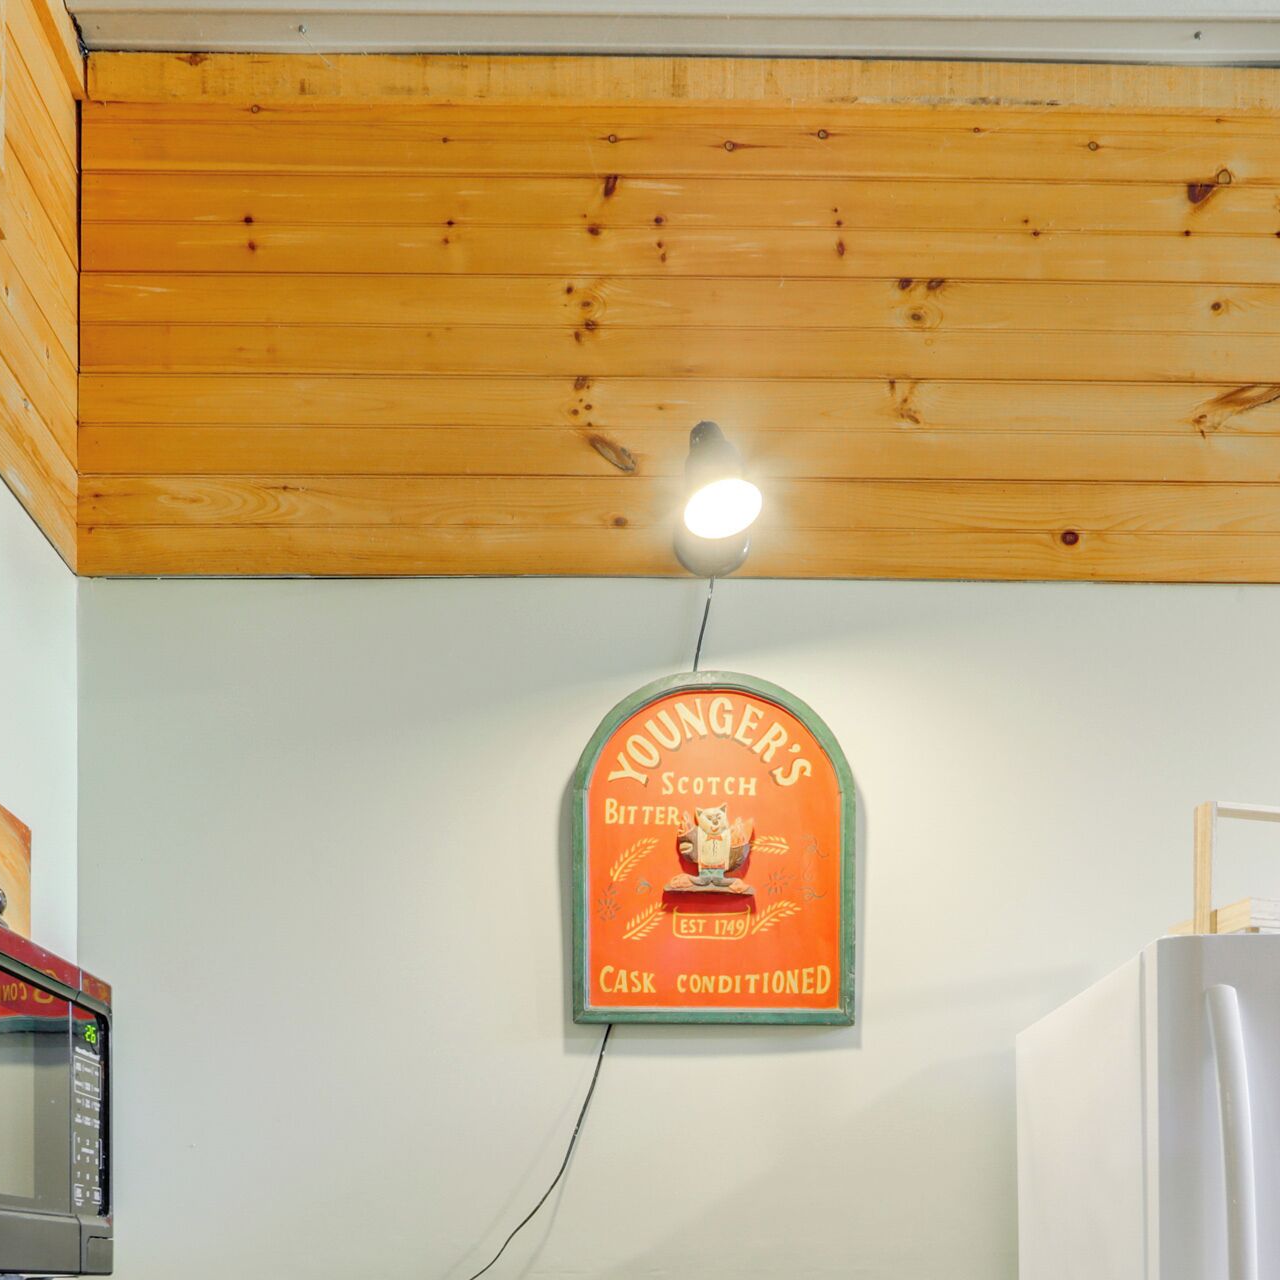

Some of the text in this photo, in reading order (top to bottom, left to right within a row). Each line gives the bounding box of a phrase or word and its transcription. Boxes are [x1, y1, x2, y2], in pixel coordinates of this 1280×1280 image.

[609, 697, 812, 787] YOUNGER'S
[662, 772, 757, 797] SCOTCH
[605, 798, 681, 826] BITTER
[680, 912, 745, 935] EST 1749
[600, 965, 831, 995] CASK CONDITIONED
